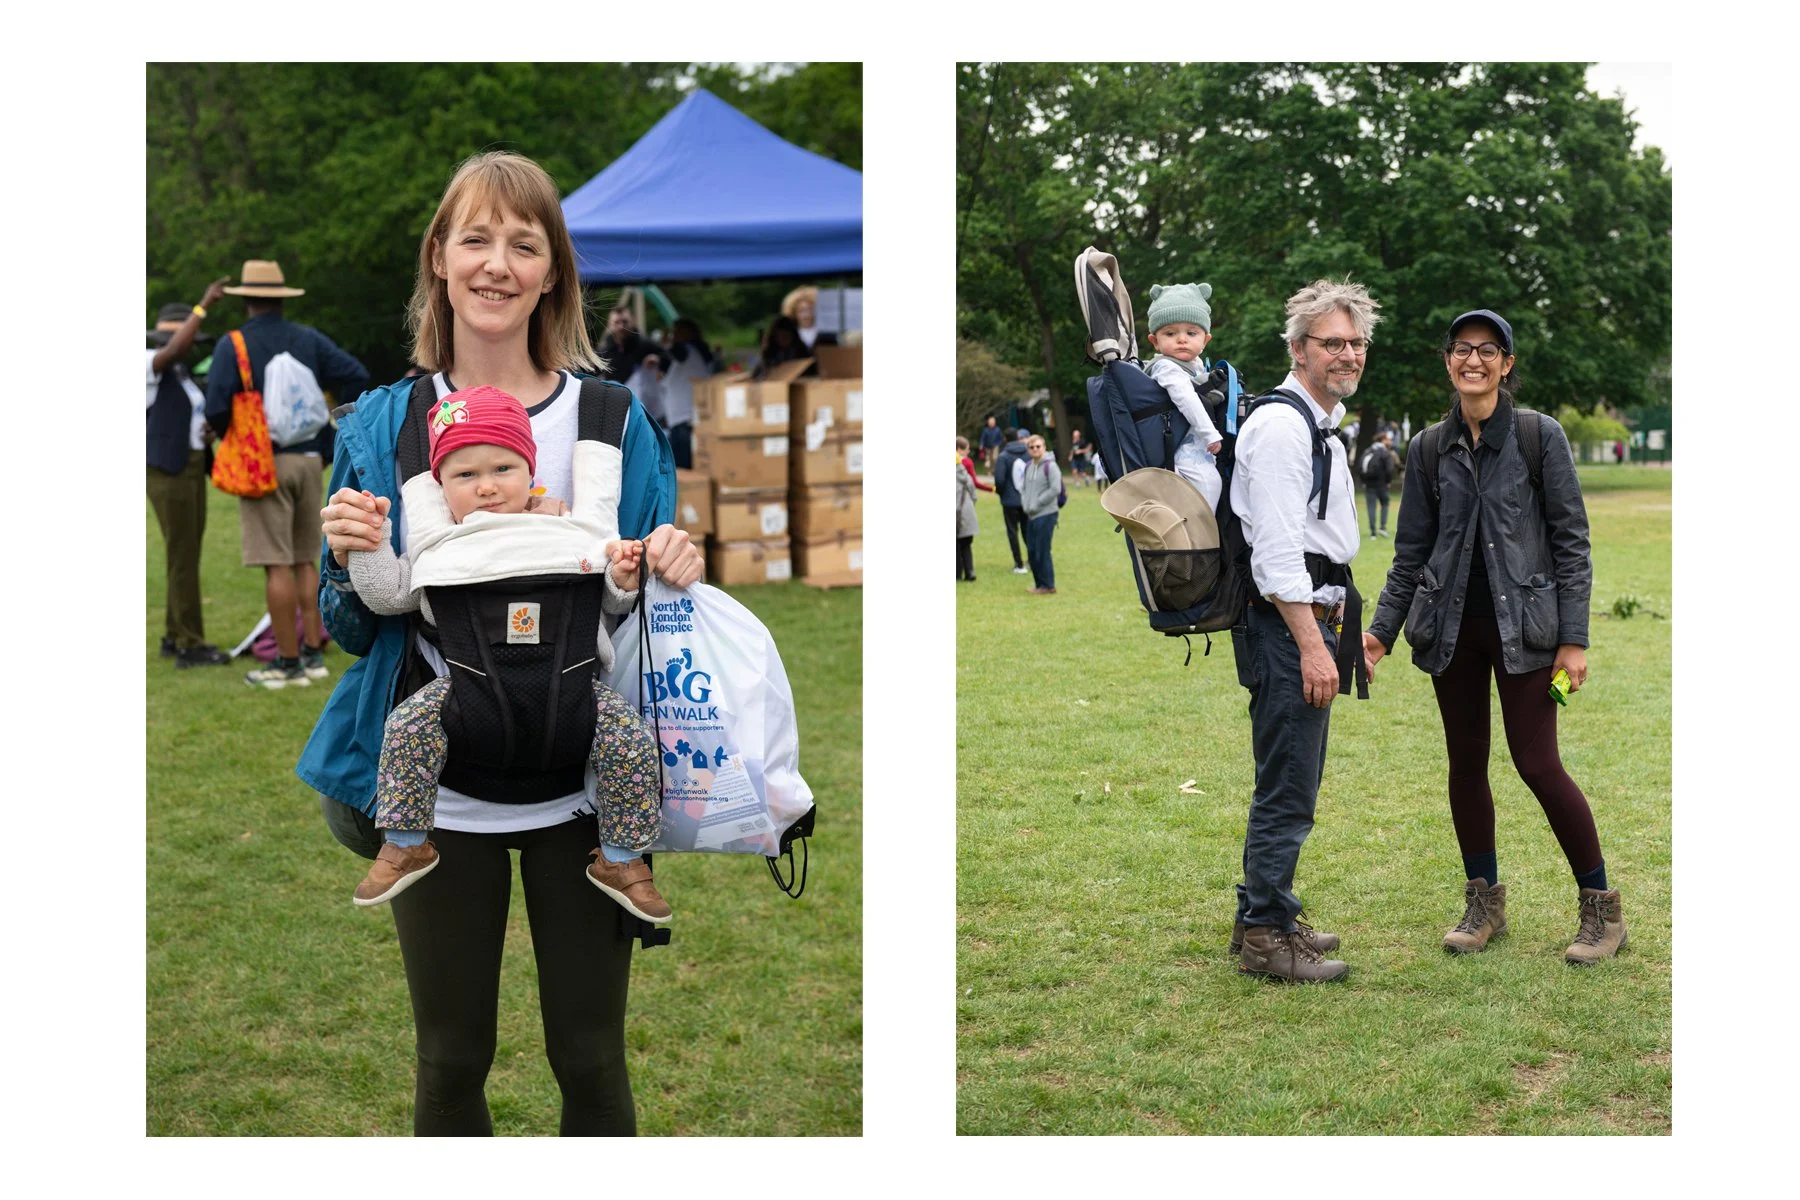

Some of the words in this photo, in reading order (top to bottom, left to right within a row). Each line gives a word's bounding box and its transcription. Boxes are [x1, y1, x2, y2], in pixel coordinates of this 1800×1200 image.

[651, 612, 691, 623] London
[651, 622, 694, 635] Hospice
[642, 706, 669, 719] FUN
[672, 705, 719, 720] WALK
[665, 788, 708, 796] #bigfunwalk
